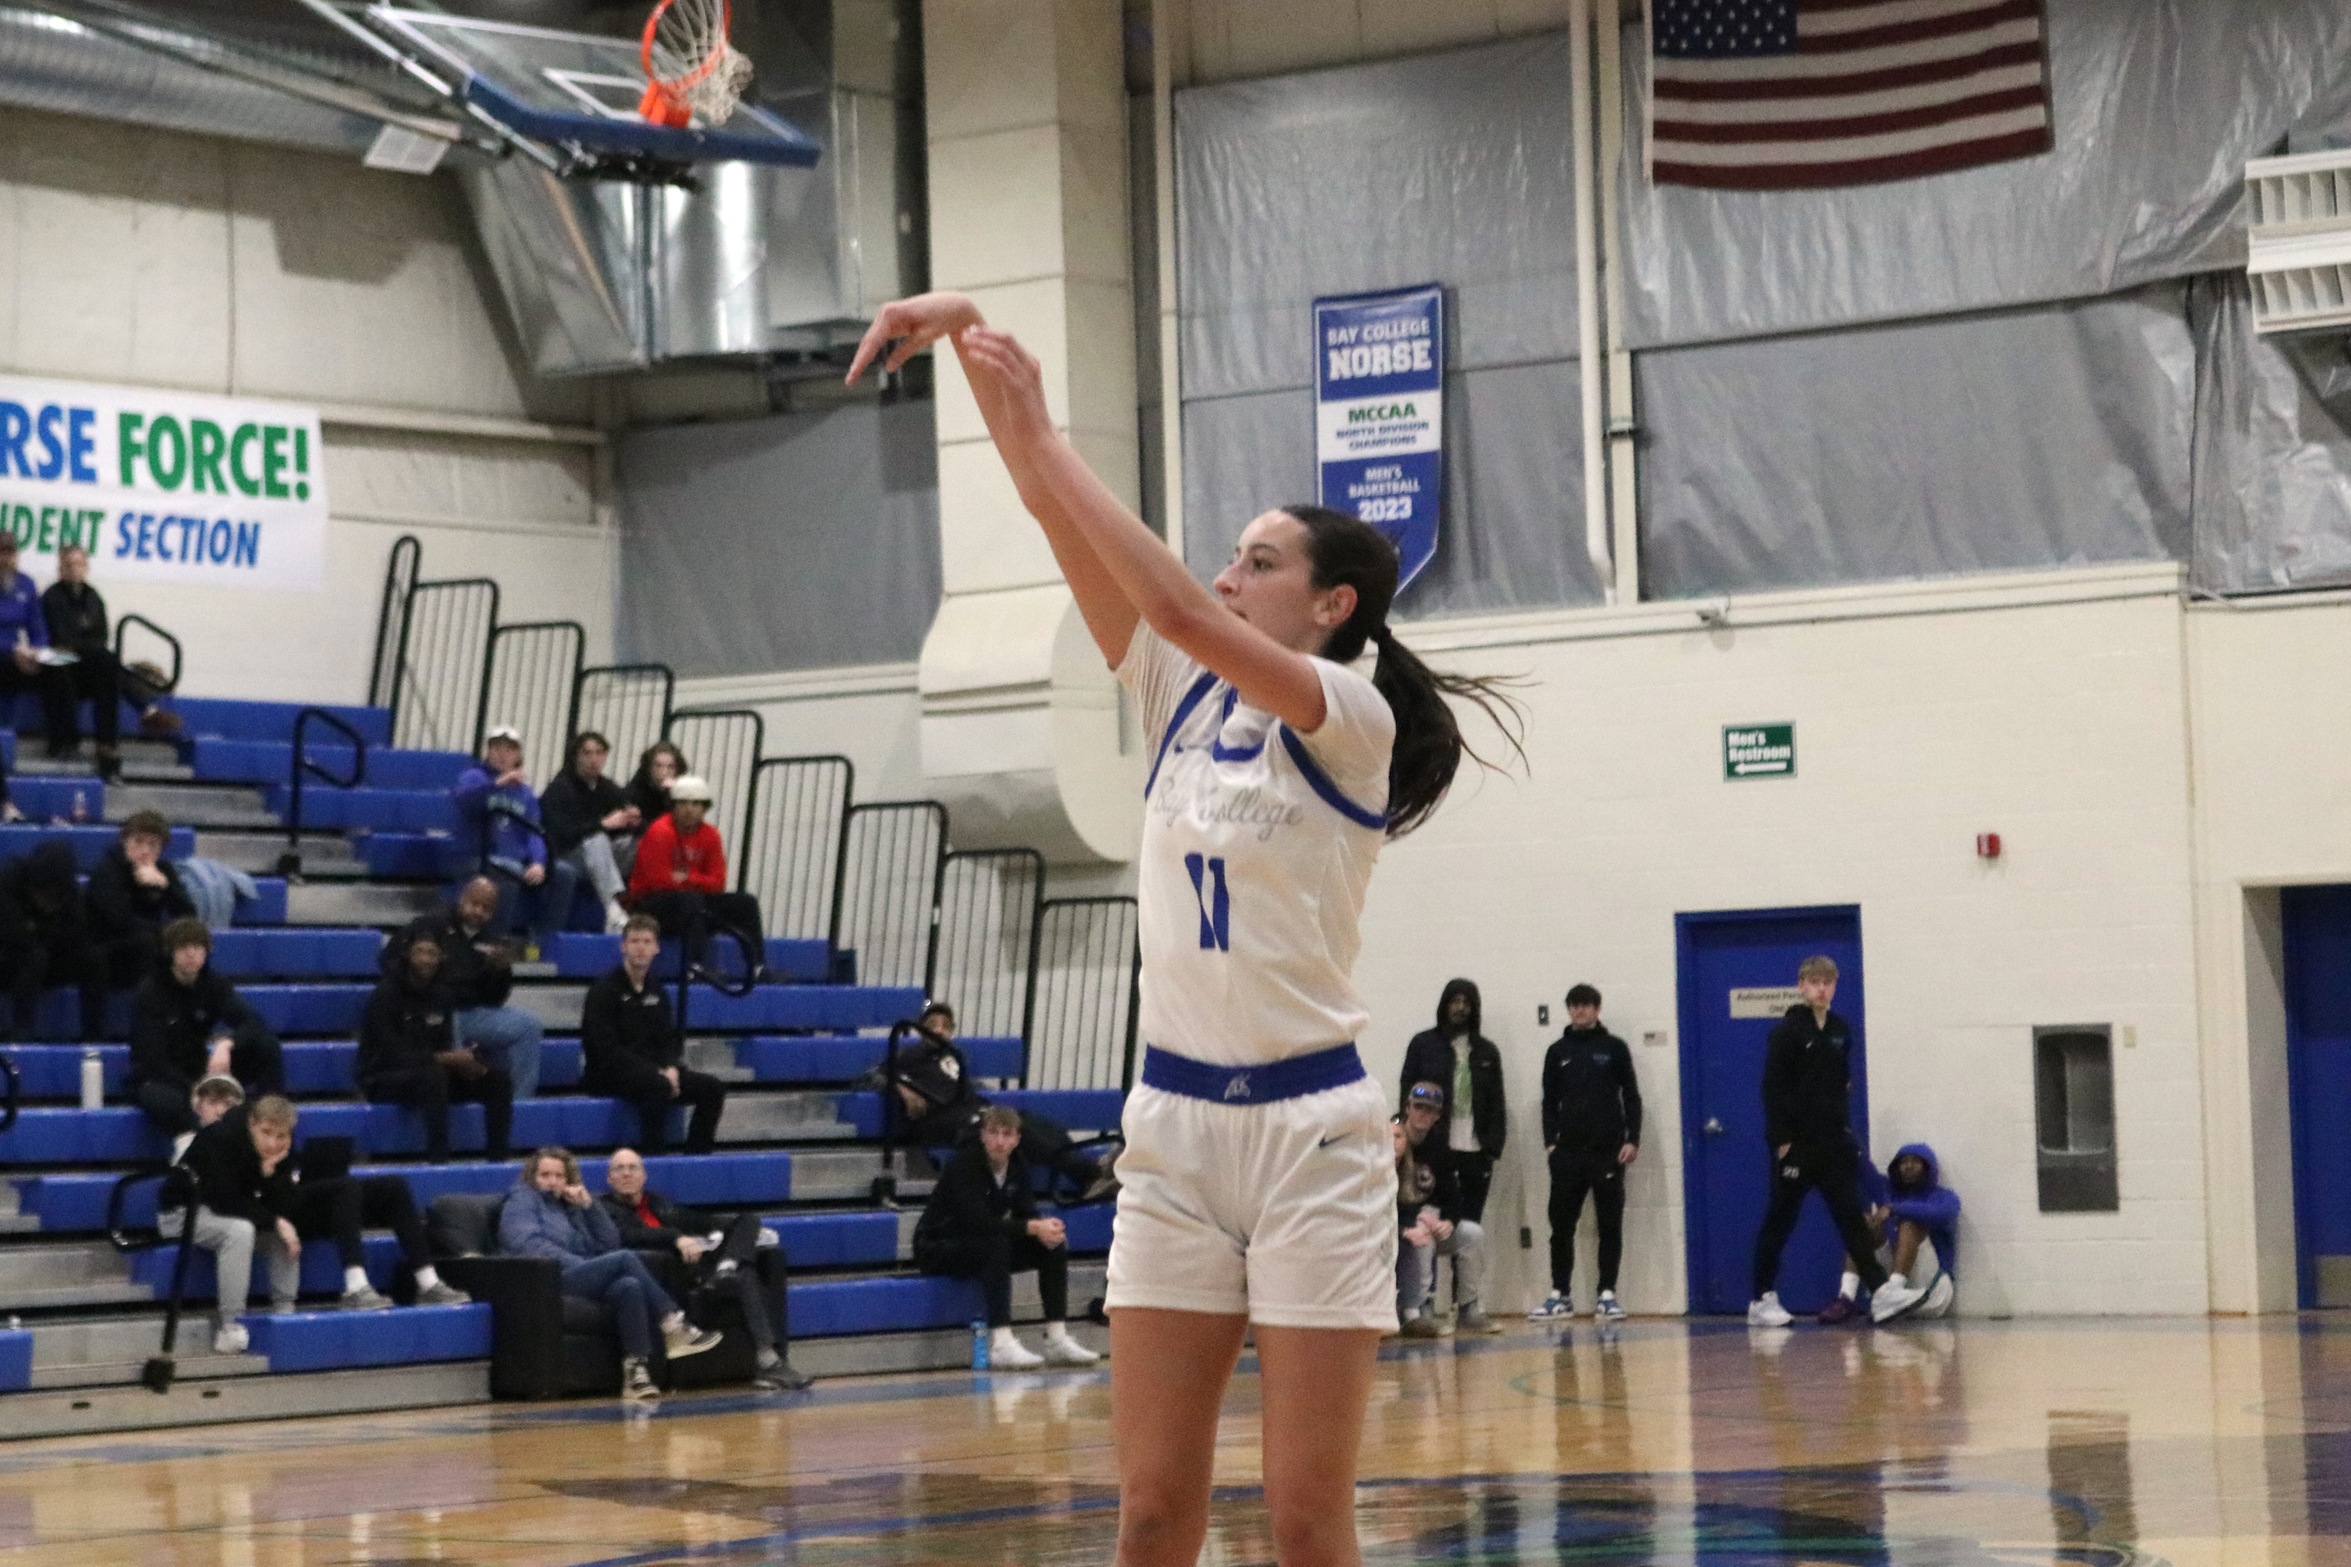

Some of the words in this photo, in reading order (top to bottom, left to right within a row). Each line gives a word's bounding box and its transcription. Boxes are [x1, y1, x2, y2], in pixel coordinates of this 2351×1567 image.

[1328, 327, 1358, 346] BAY
[1363, 318, 1430, 341] COLLEGE
[1329, 338, 1431, 380] NORSE
[1348, 402, 1417, 423] MCCAA
[118, 410, 310, 501] FORCE!
[1365, 465, 1402, 480] MEN'S
[1349, 479, 1420, 499] BASKETBALL
[1358, 496, 1412, 521] 2023
[115, 511, 261, 568] SECTION
[1728, 731, 1766, 747] Men's
[1729, 746, 1791, 762] Restroom
[1184, 852, 1230, 953] 11
